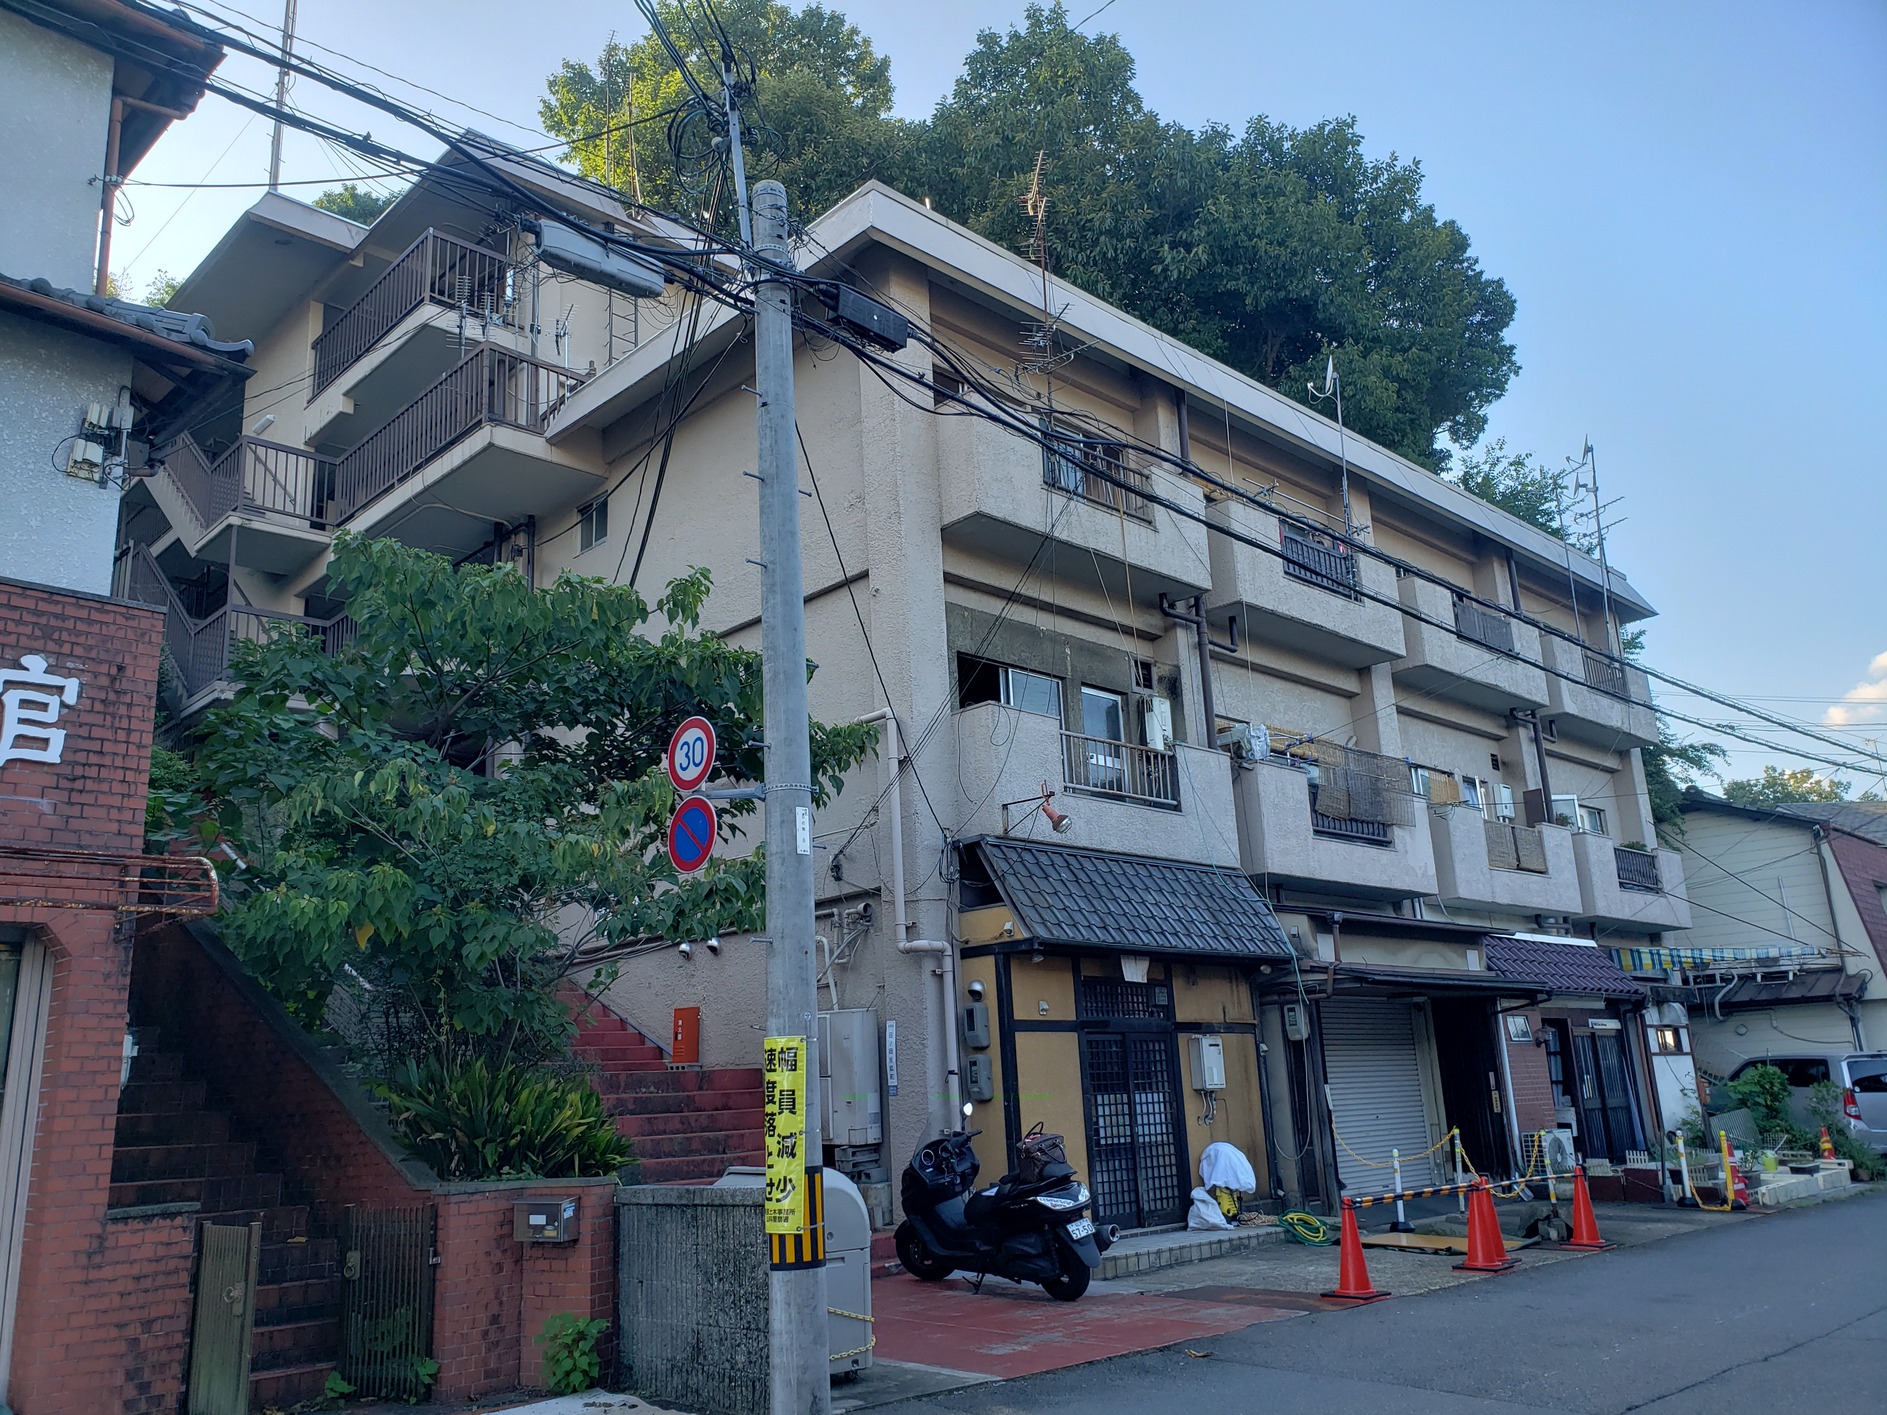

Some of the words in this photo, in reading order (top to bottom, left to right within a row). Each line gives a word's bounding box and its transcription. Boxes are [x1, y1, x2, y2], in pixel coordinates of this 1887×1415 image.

[679, 737, 704, 772] 30
[776, 1046, 798, 1203] 幅員減少
